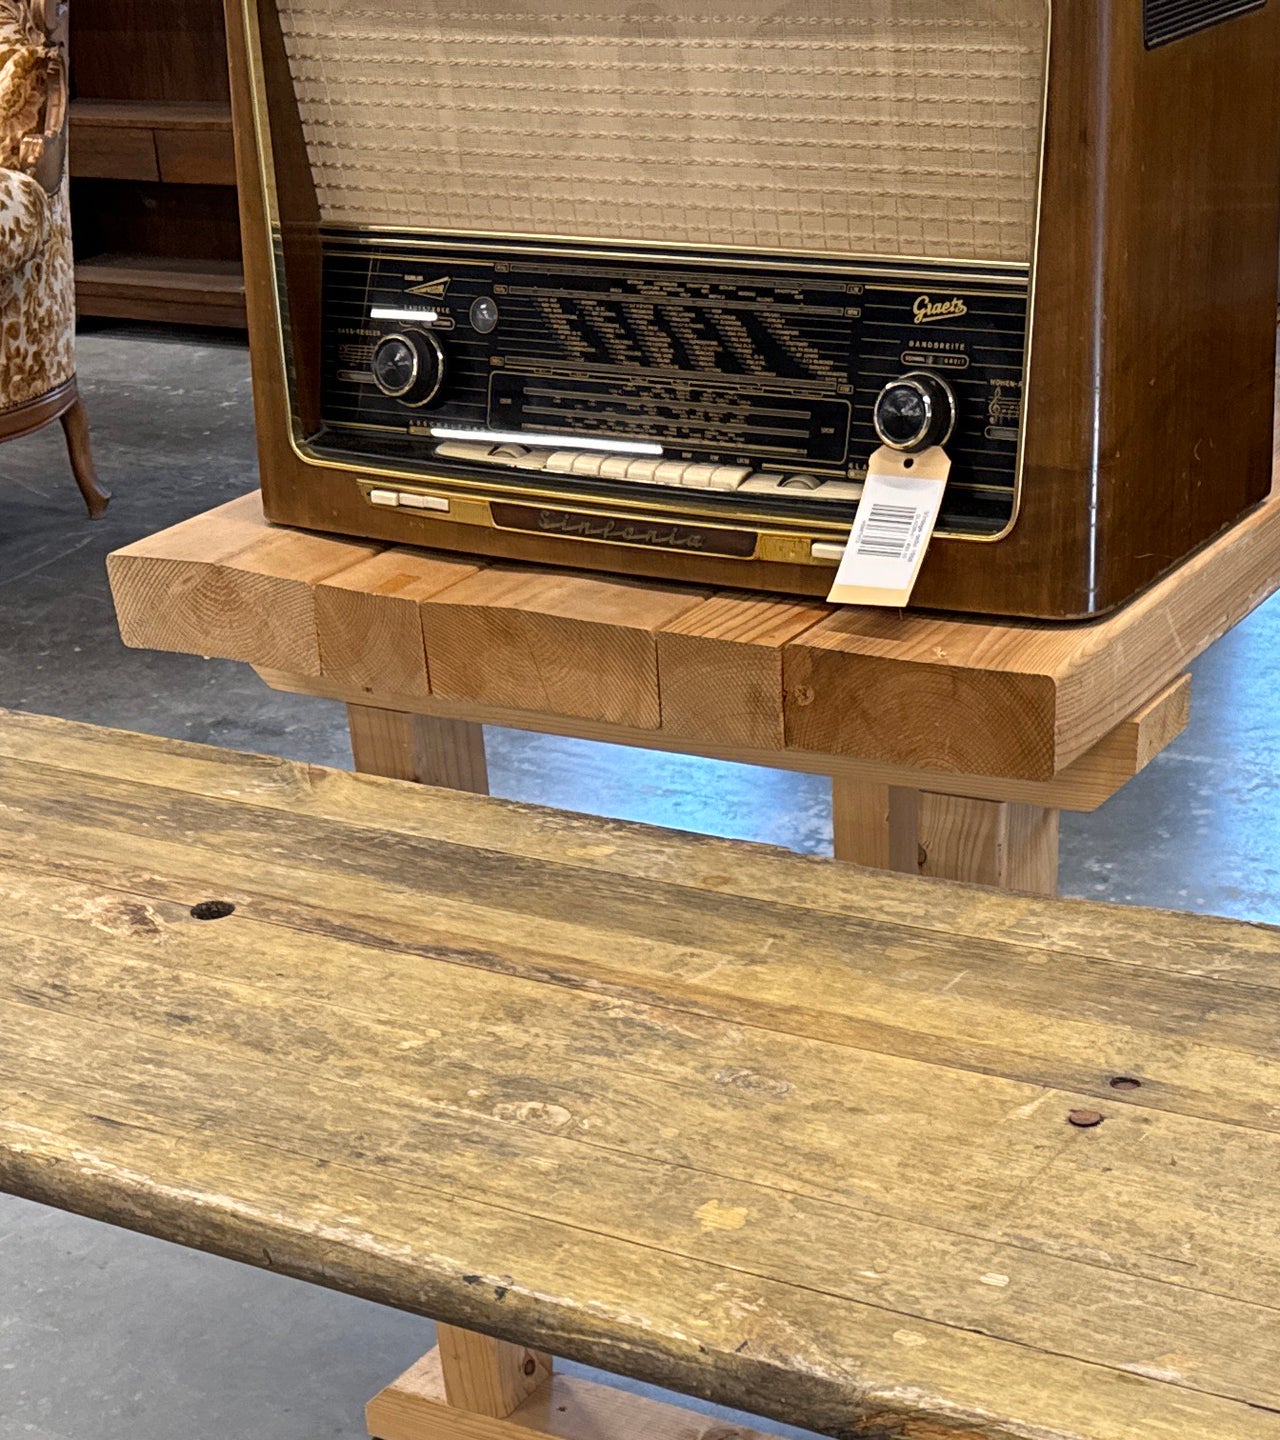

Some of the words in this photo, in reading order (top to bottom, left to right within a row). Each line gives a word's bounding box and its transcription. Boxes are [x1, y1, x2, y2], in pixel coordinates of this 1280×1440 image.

[912, 295, 968, 324] Graetz
[908, 340, 966, 350] BANDBREITE
[537, 510, 705, 549] Sinfonia
